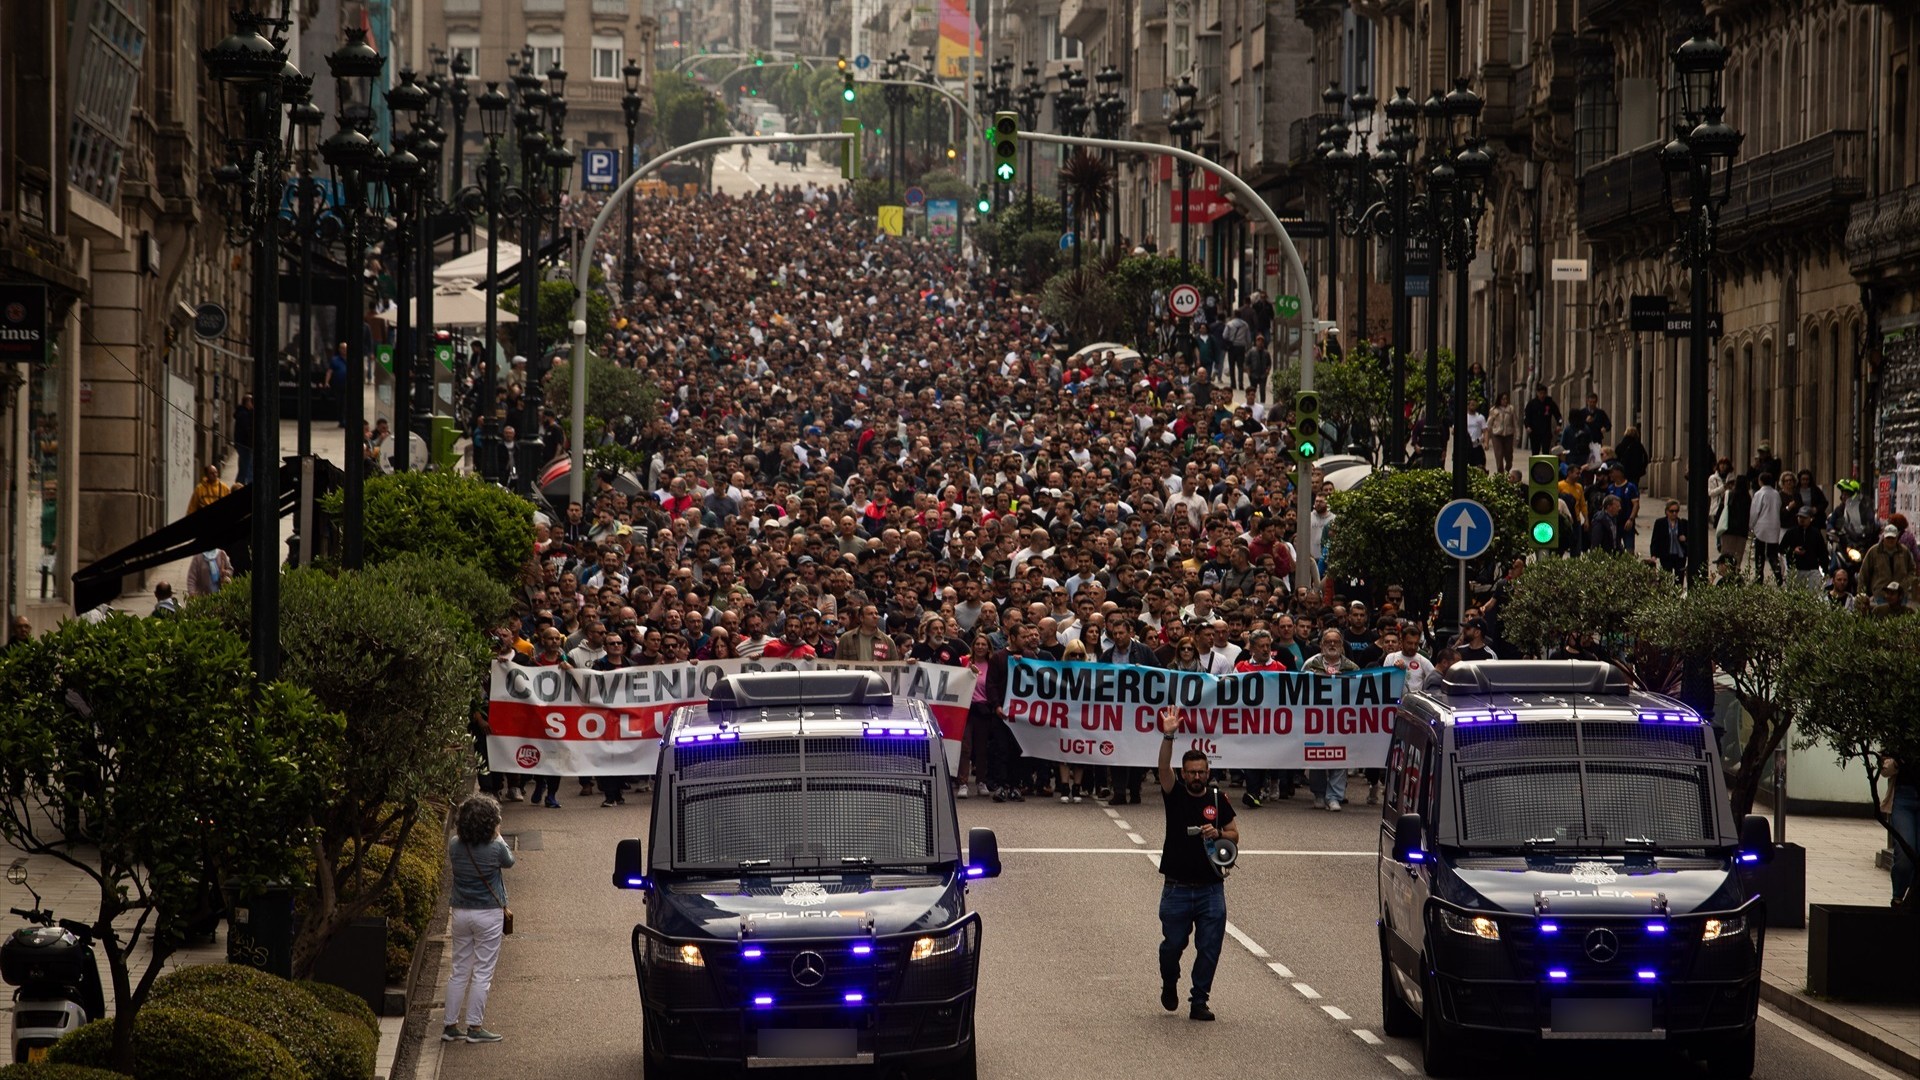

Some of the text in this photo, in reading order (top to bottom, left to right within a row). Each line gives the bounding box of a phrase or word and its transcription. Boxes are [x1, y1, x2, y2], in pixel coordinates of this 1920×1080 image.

[592, 154, 609, 174] P
[1176, 294, 1194, 305] 40
[505, 664, 724, 705] CONVENIO
[1012, 663, 1402, 707] COMERCIO DO METAL
[1008, 699, 1069, 729] POR
[1081, 704, 1123, 732] UN
[1304, 706, 1397, 735] DIGNO
[519, 747, 538, 758] UGT
[1060, 738, 1097, 755] UGT
[1306, 748, 1345, 760] CCOO
[1541, 889, 1636, 898] POLICIA
[748, 910, 843, 921] POLICIA
